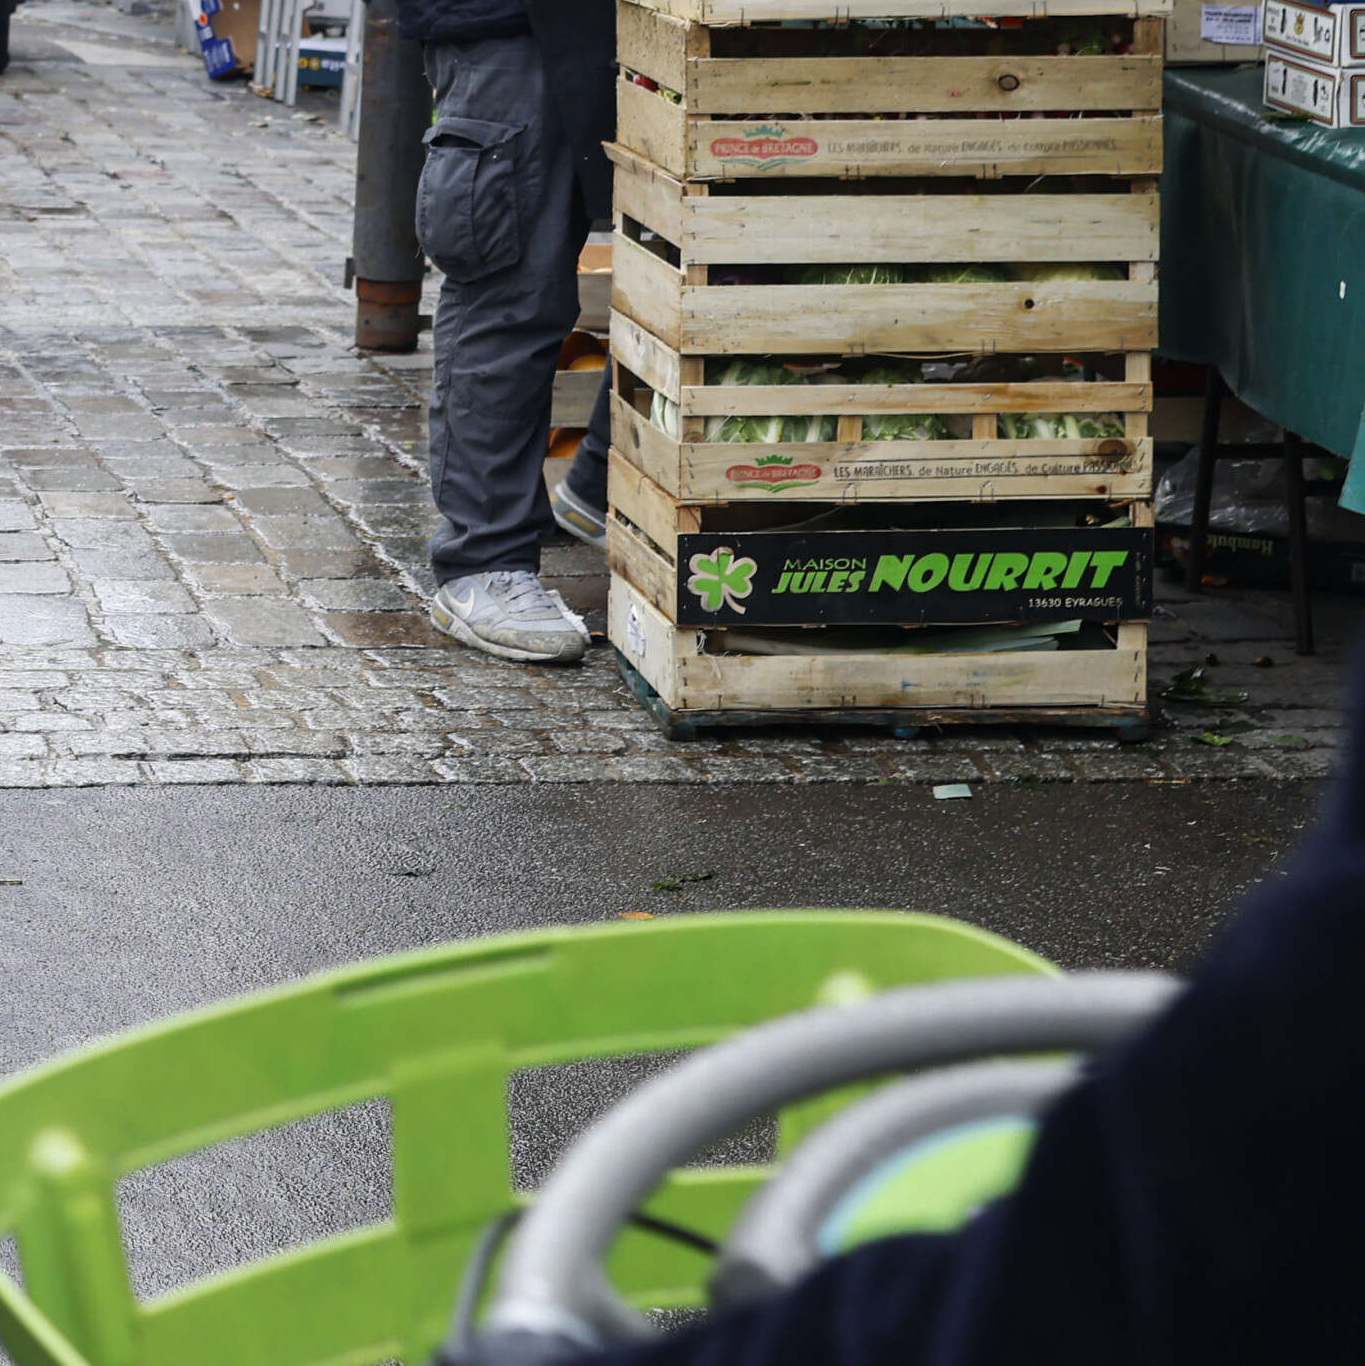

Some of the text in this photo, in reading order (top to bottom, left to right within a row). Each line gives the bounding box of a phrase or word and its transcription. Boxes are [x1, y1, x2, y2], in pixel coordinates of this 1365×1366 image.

[834, 466, 851, 478] LES
[918, 466, 932, 476] de
[936, 465, 972, 477] Nature
[1025, 464, 1038, 474] de
[784, 559, 867, 571] MAISON
[771, 571, 866, 594] JULES
[868, 551, 1130, 593] NOURRIT
[1029, 597, 1124, 608] 13630 EYRAGUES
